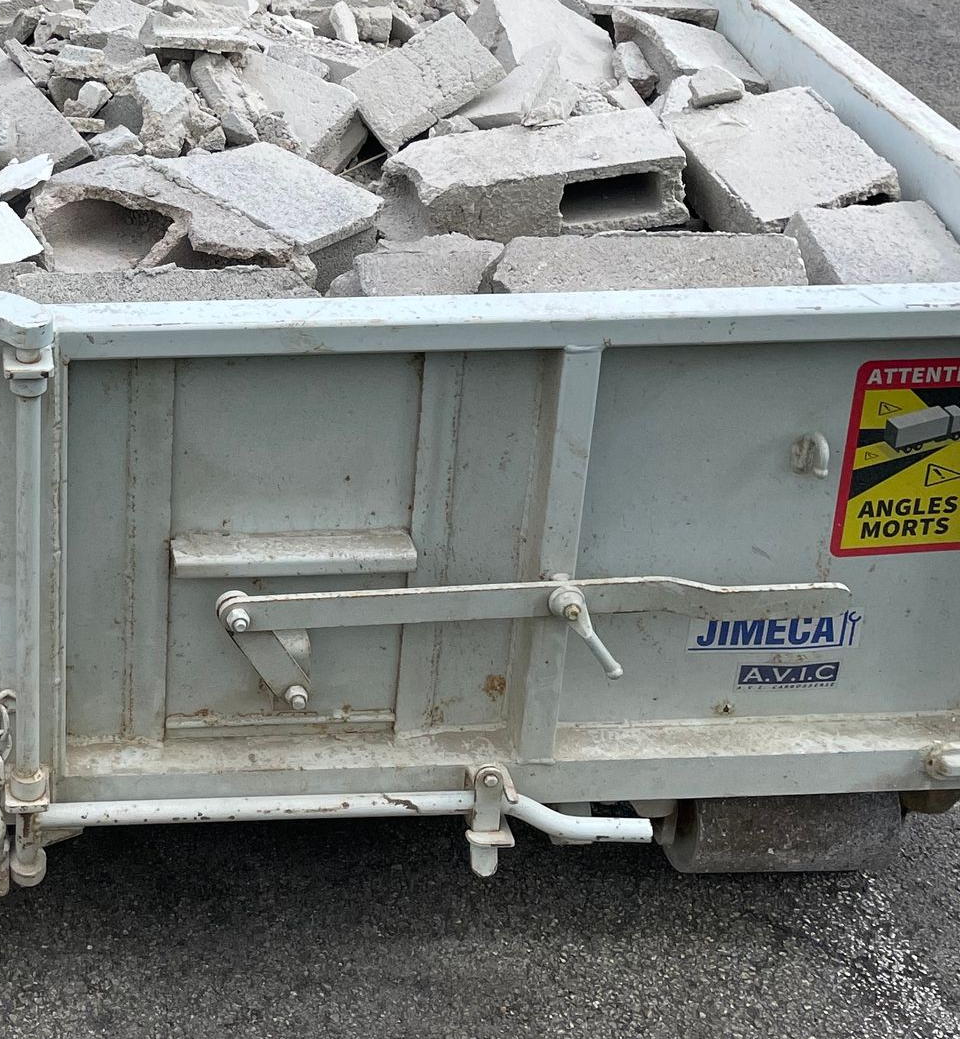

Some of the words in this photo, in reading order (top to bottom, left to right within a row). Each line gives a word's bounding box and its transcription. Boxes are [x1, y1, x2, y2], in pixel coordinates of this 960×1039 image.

[857, 495, 959, 519] ANGLES
[860, 517, 951, 540] MORTS
[696, 616, 835, 647] JIMECA
[742, 664, 836, 682] A.V.I.C
